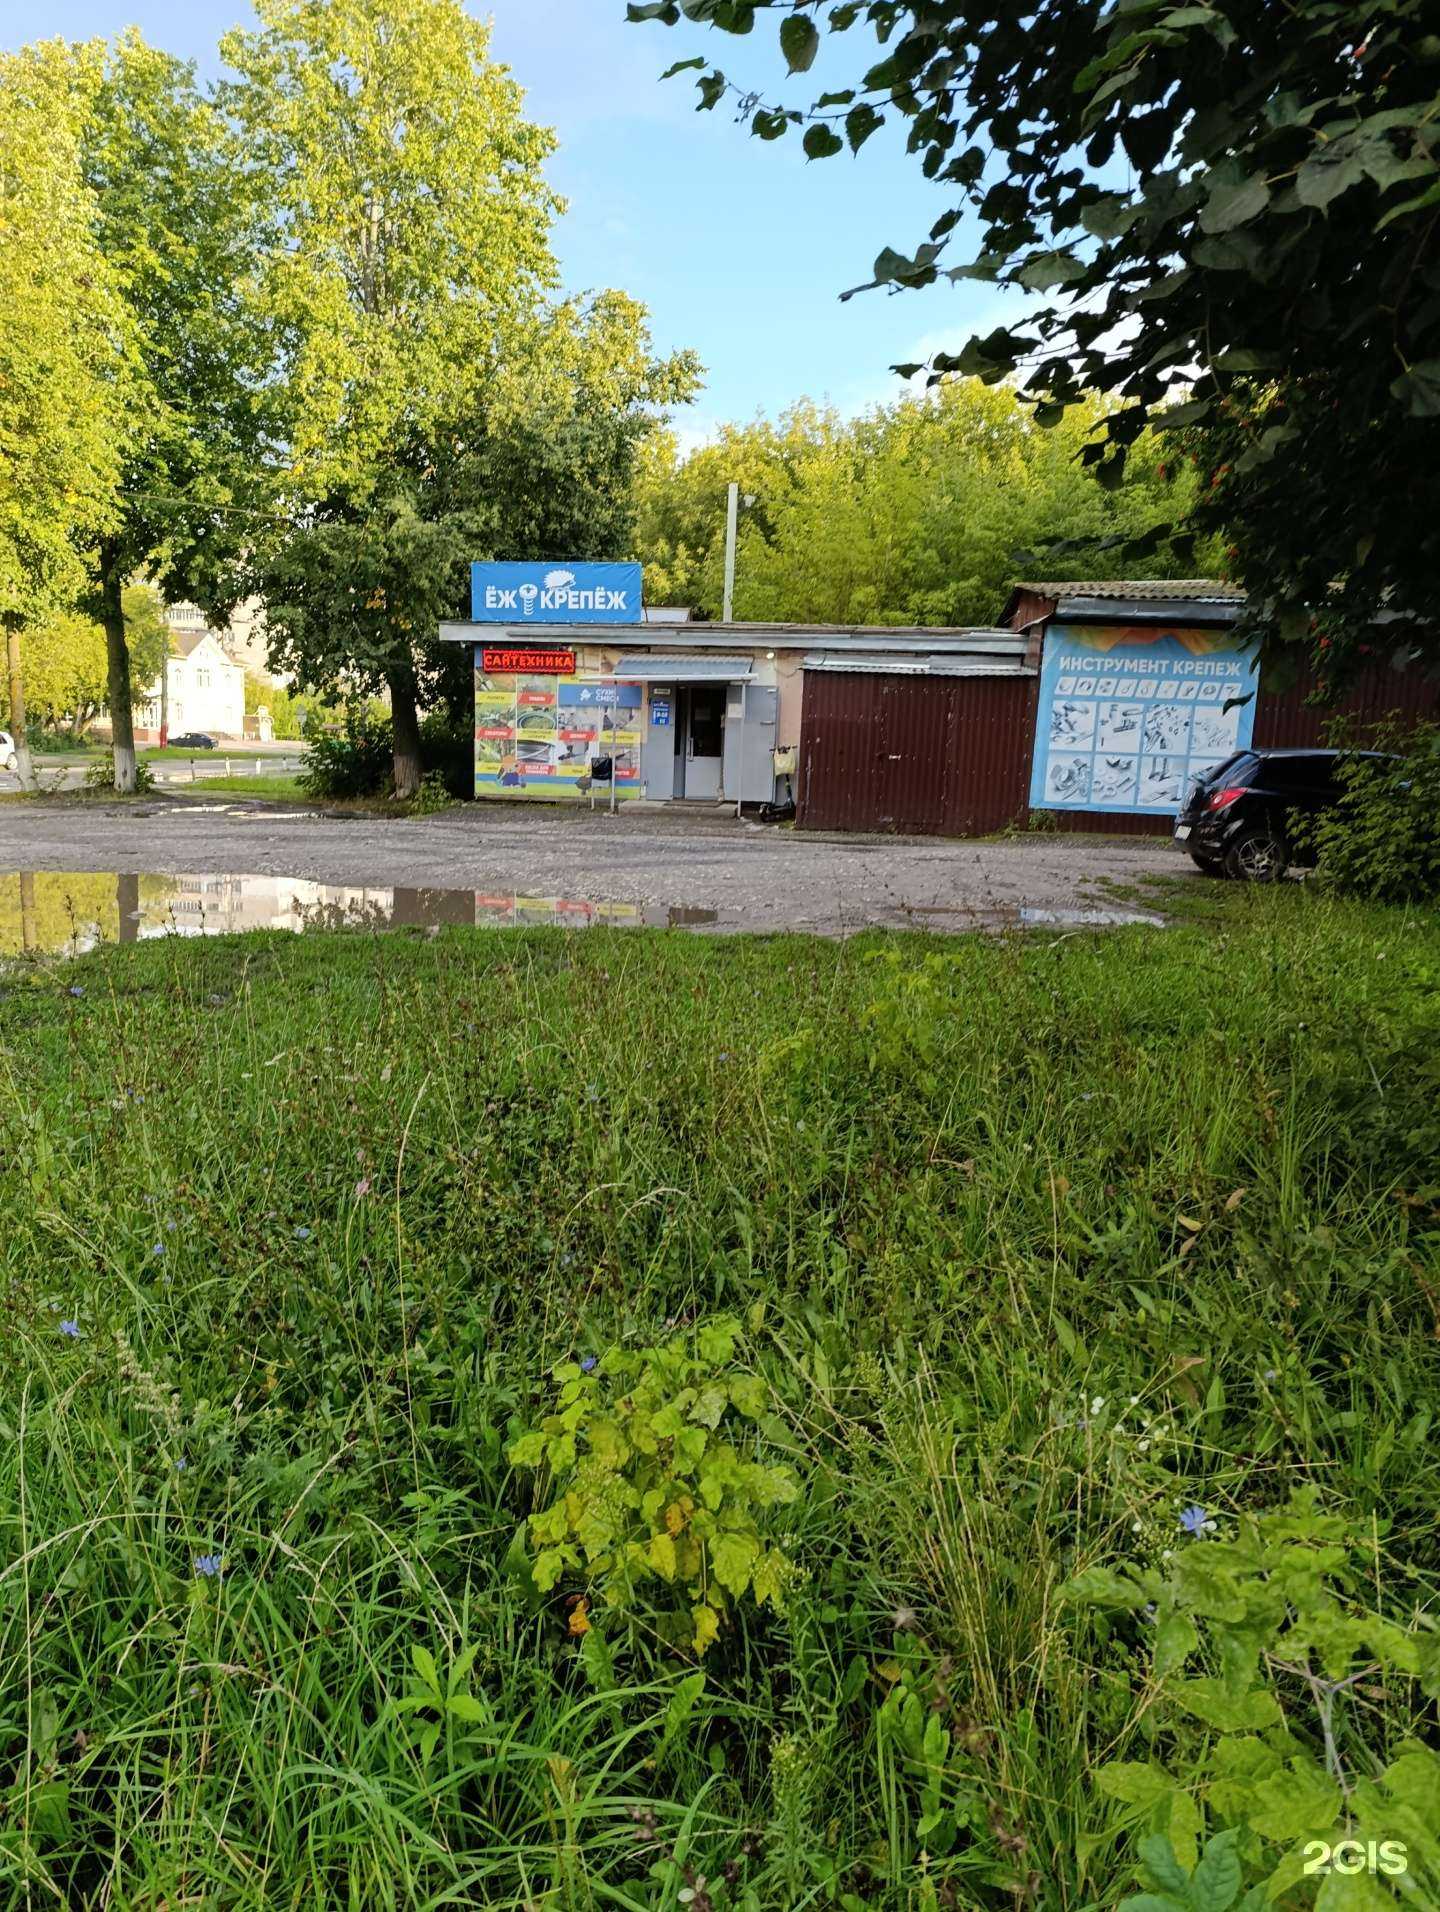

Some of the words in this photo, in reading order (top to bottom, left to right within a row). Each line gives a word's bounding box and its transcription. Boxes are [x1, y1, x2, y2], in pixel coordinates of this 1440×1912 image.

[485, 586, 517, 609] ЁЖ
[540, 586, 627, 610] КРЕПЁЖ
[485, 655, 573, 668] САНТЕХНИКА
[1059, 656, 1169, 674] ИНСТРУМЕНТ
[1173, 659, 1242, 676] КРЕПЕЖ
